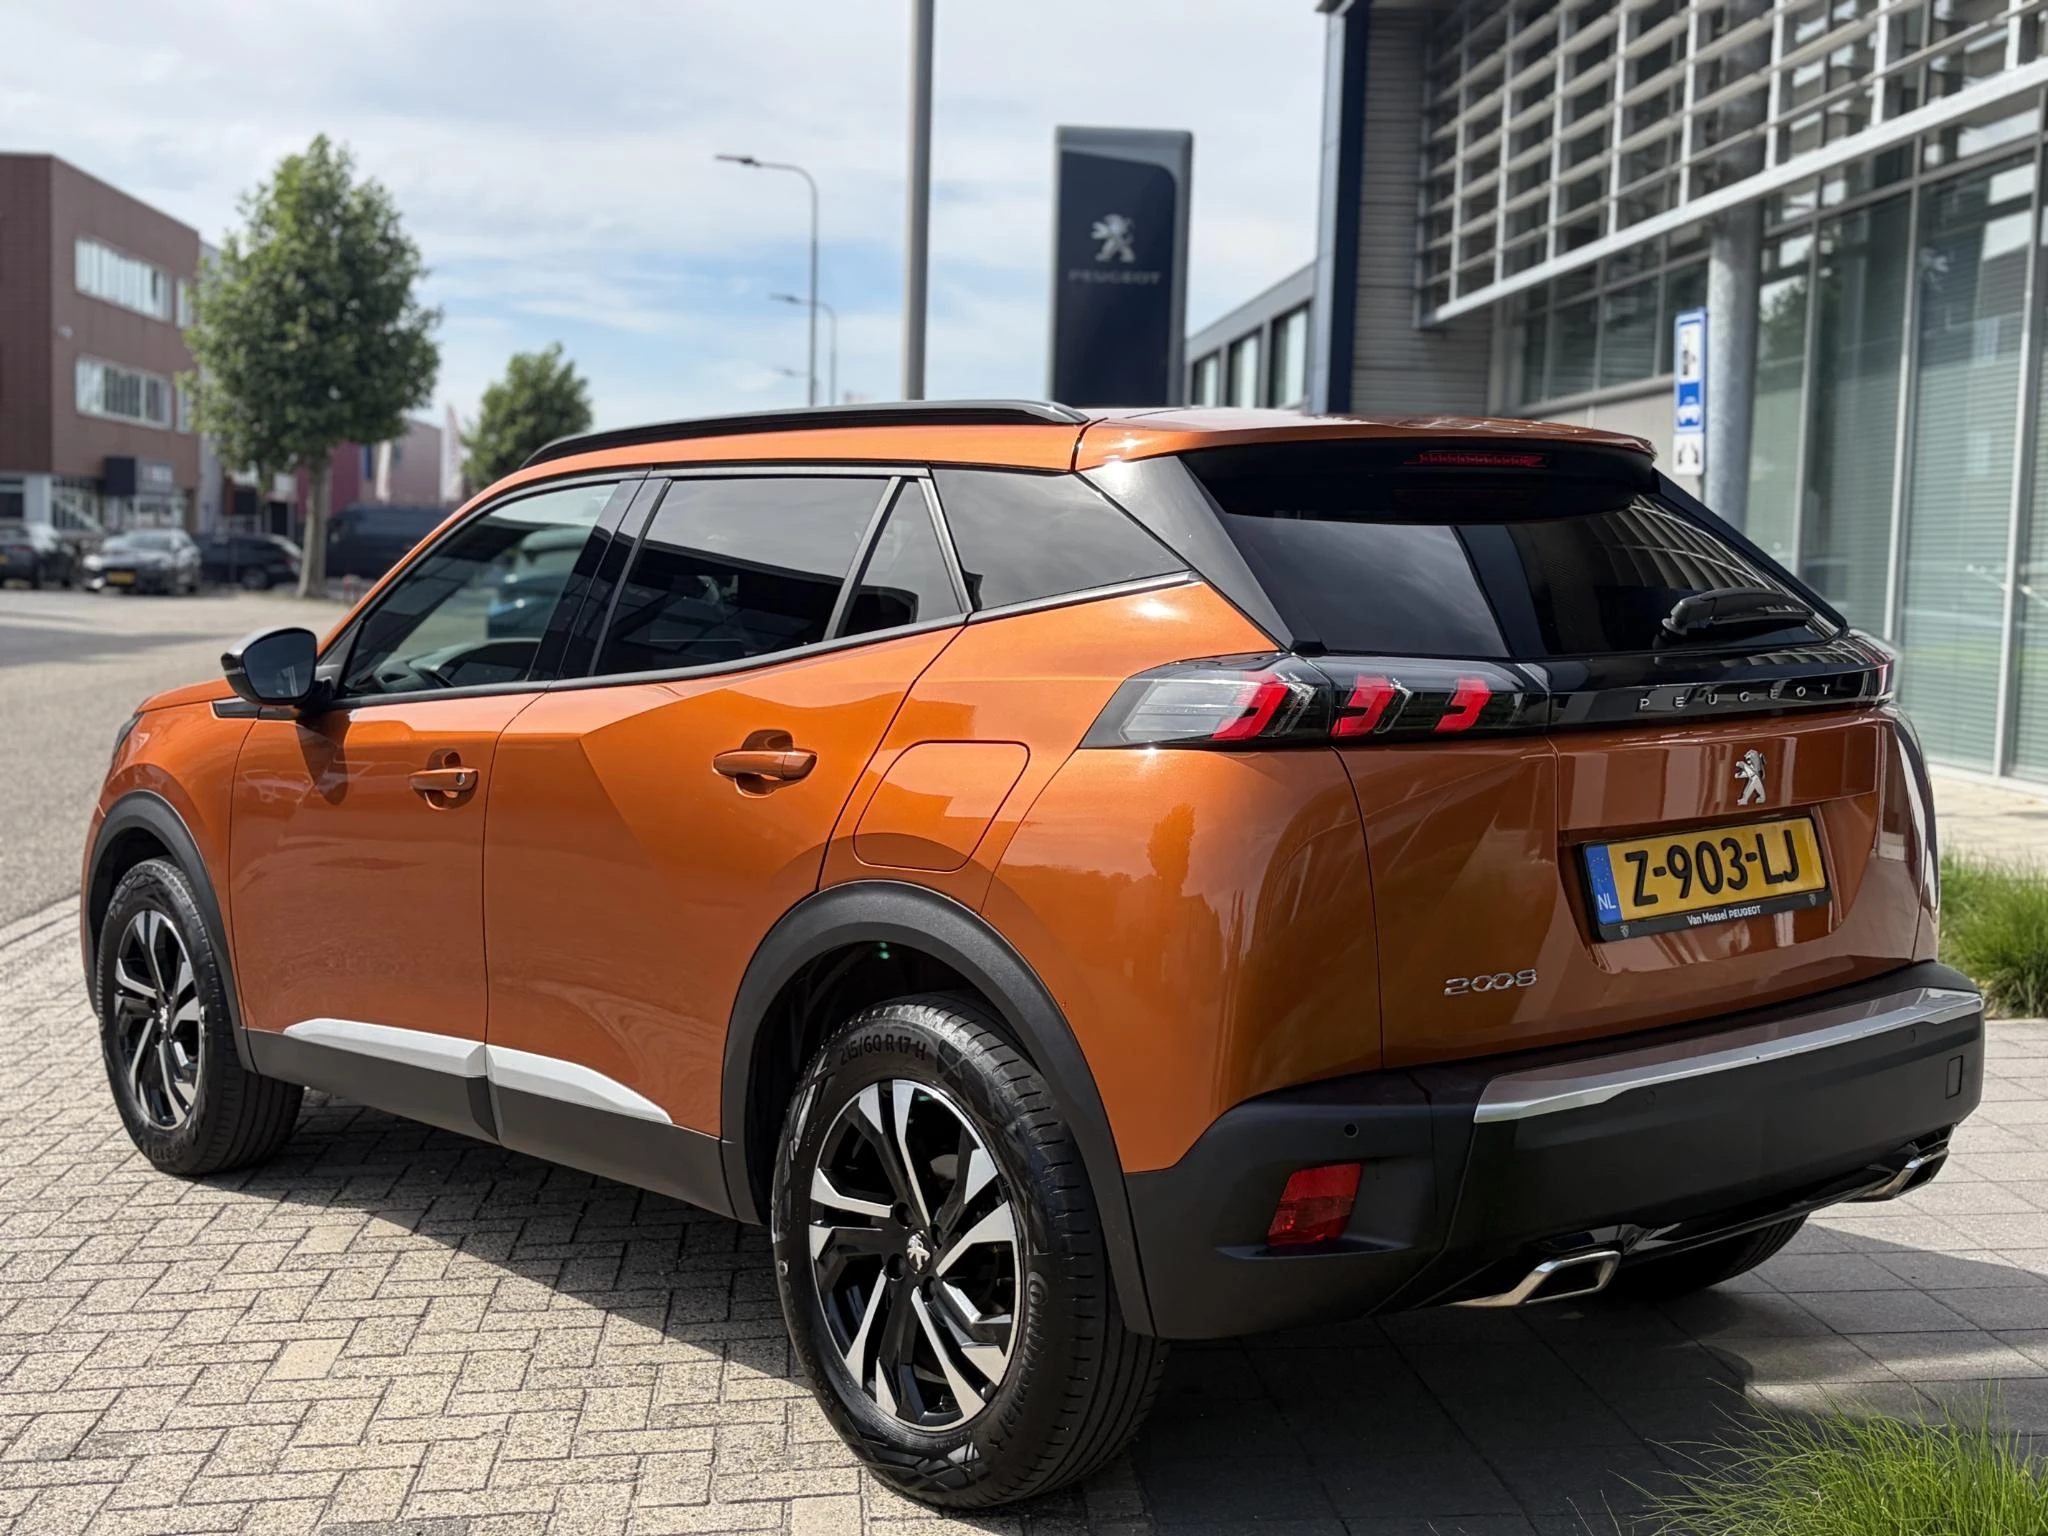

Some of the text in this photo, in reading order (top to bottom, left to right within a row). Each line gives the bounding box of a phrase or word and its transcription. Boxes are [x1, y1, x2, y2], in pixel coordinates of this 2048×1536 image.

[1639, 684, 1831, 711] PEUGEOT
[1624, 829, 1800, 907] Z-903-LJ
[1597, 893, 1617, 911] NL
[1687, 905, 1761, 926] Van Mossel PEUGEOT
[1444, 969, 1537, 995] 2008
[840, 1034, 881, 1066] 215/60
[885, 1034, 895, 1052] R
[914, 1040, 927, 1060] H
